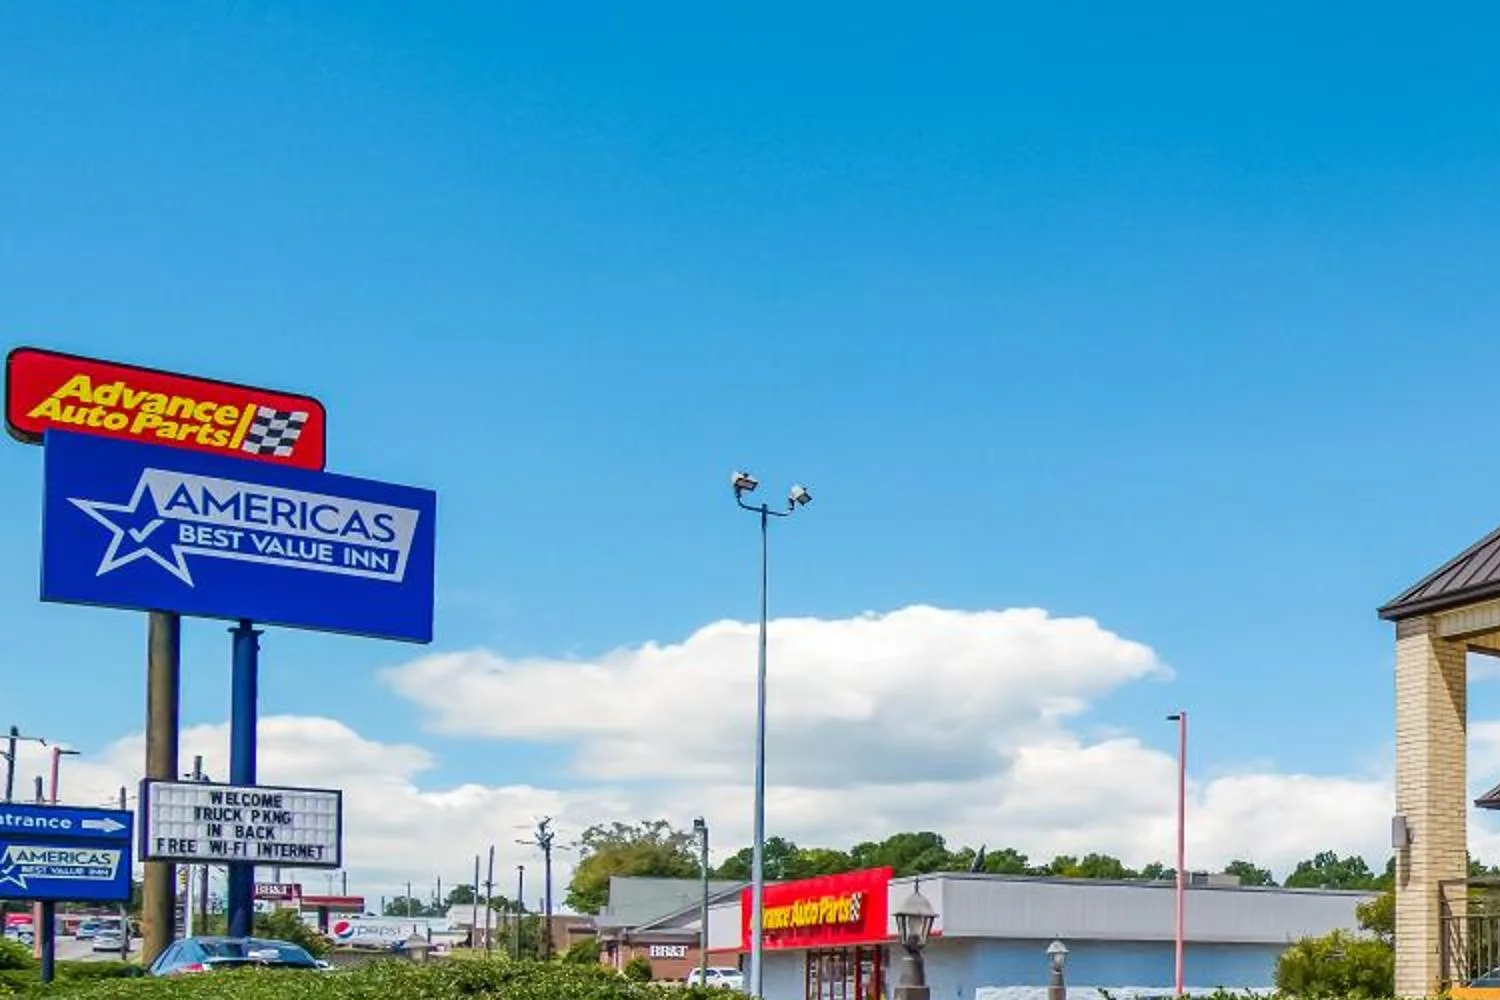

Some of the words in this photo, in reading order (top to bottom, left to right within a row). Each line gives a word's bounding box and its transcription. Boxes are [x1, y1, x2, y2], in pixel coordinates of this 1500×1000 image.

[52, 373, 240, 425] Advance
[26, 397, 129, 430] Auto
[129, 411, 231, 447] Parts
[164, 482, 395, 543] AMERICAS
[179, 523, 244, 549] BEST
[250, 533, 333, 562] VALUE
[344, 549, 389, 571] INN
[211, 791, 283, 808] WELCOME
[194, 806, 241, 822] TRUCK
[251, 809, 291, 824] PKNG
[207, 823, 222, 837] IN
[235, 825, 275, 840] BACK
[16, 849, 112, 865] AMERICAS
[157, 838, 197, 853] FREE
[209, 841, 247, 855] WI-FI
[257, 843, 324, 860] INTERNET
[789, 898, 819, 927] Auto
[818, 895, 852, 924] Parts
